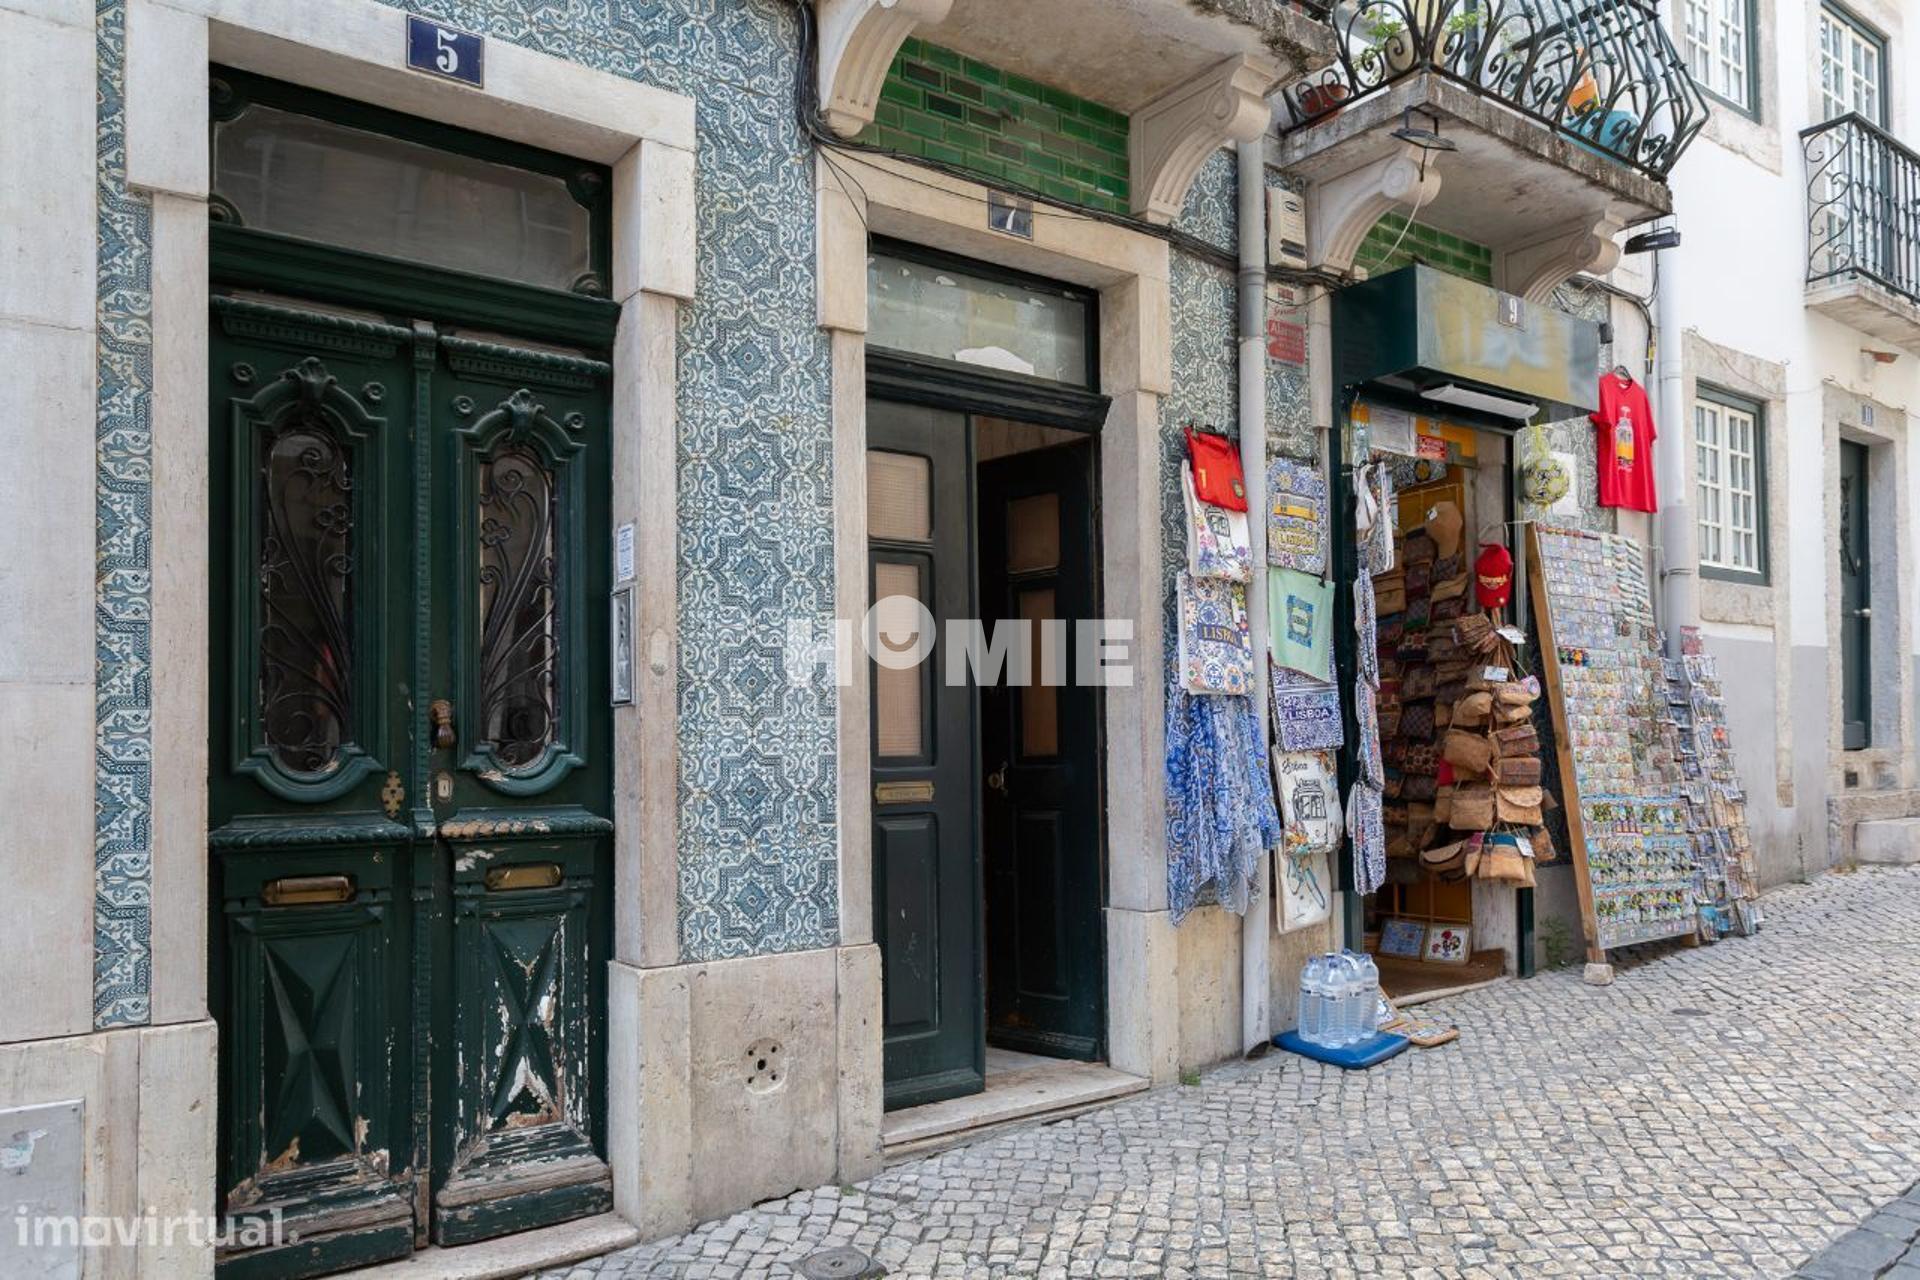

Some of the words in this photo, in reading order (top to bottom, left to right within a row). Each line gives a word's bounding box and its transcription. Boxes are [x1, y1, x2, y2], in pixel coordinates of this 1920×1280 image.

[436, 28, 458, 73] 5
[1004, 196, 1018, 231] 7
[1509, 297, 1518, 324] 9
[1288, 708, 1330, 720] LISBOA
